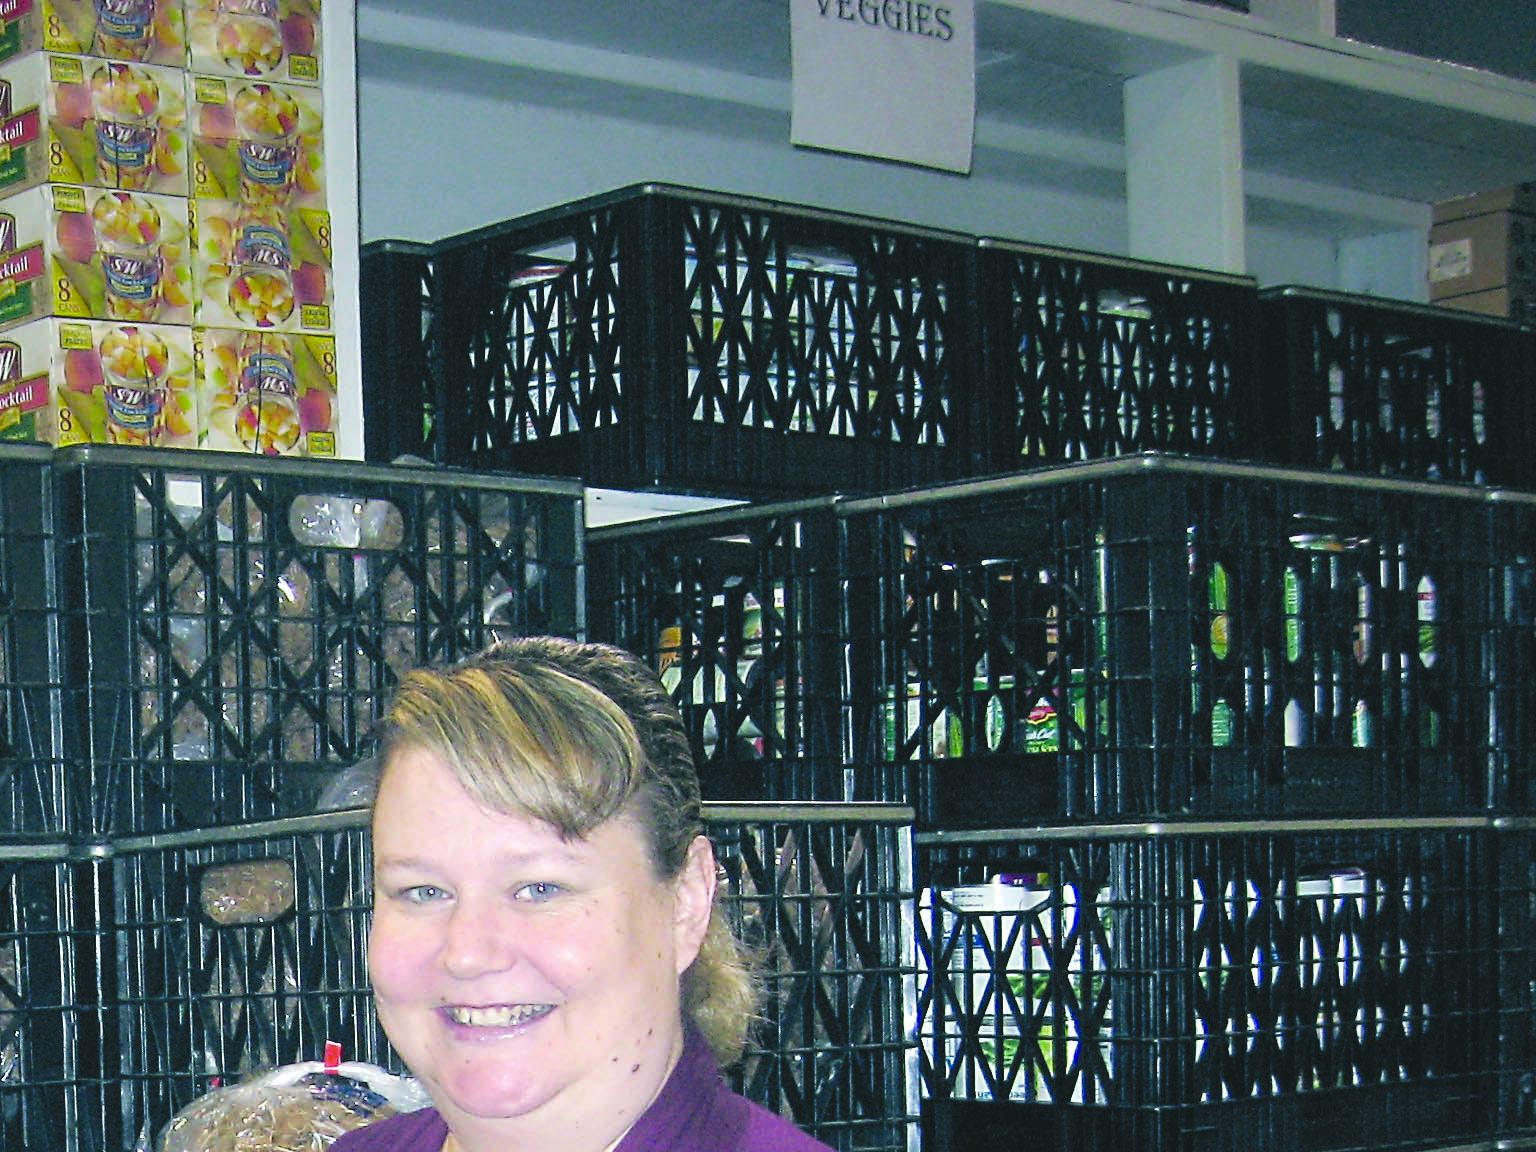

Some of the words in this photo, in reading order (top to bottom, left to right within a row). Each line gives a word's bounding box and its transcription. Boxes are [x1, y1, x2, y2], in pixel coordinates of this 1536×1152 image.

[49, 15, 61, 38] 8
[816, 0, 953, 41] VEGGIES
[50, 142, 62, 166] 8
[195, 160, 207, 184] 8
[319, 226, 330, 249] 8
[58, 278, 71, 301] 8
[323, 352, 335, 374] 8
[60, 408, 72, 431] 8
